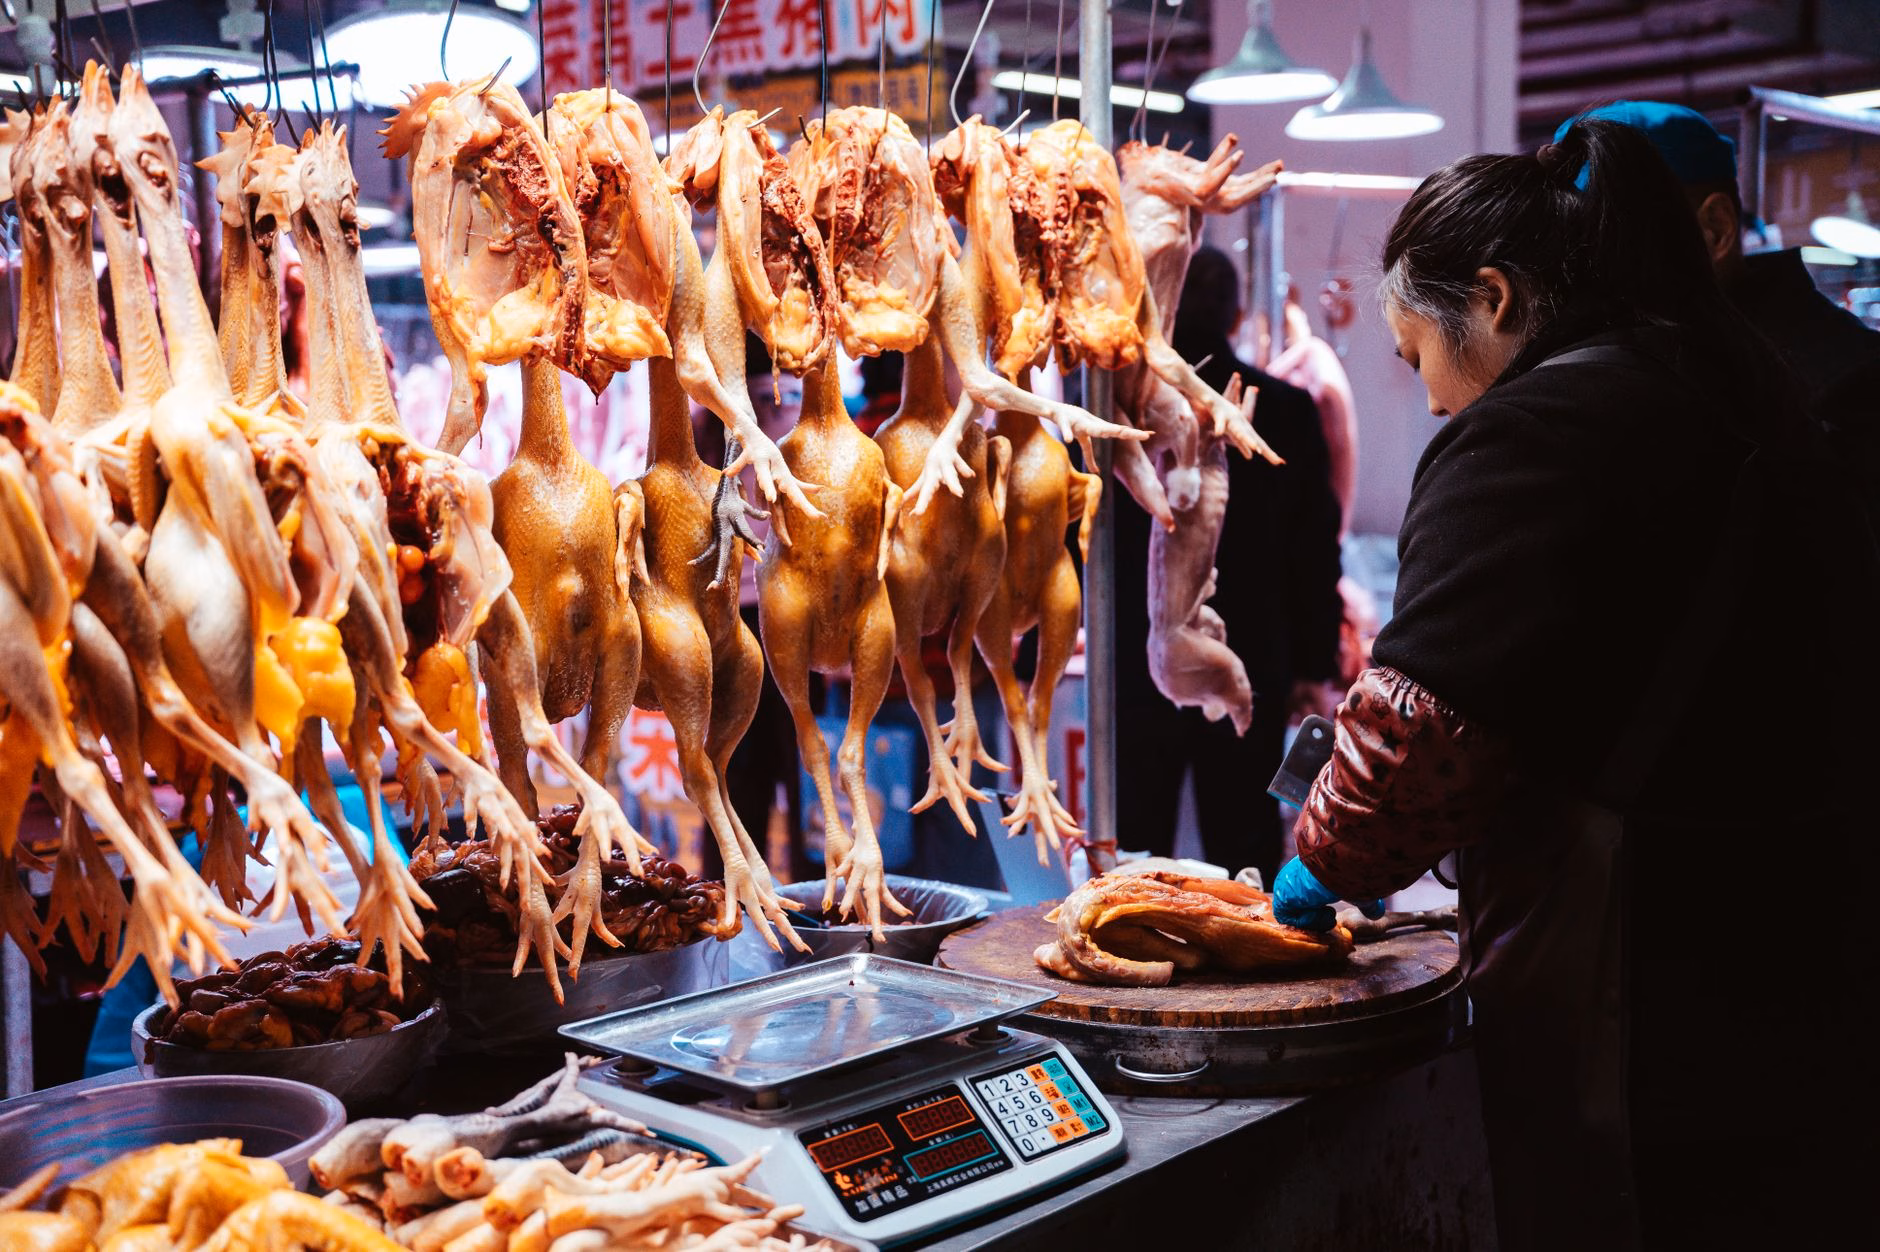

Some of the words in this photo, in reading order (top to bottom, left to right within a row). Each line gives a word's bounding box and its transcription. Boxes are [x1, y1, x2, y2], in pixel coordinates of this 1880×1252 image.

[984, 1084, 995, 1097] 1
[1000, 1079, 1013, 1092] 2
[1016, 1073, 1029, 1086] 3
[998, 1102, 1008, 1114] 4
[1012, 1096, 1025, 1109] 5
[1029, 1090, 1041, 1104] 6
[1073, 1098, 1089, 1109] M1
[1008, 1120, 1019, 1133] 7
[1025, 1114, 1038, 1128] 8
[1041, 1108, 1054, 1122] 9
[1085, 1115, 1100, 1127] M2
[1022, 1138, 1034, 1152] 0
